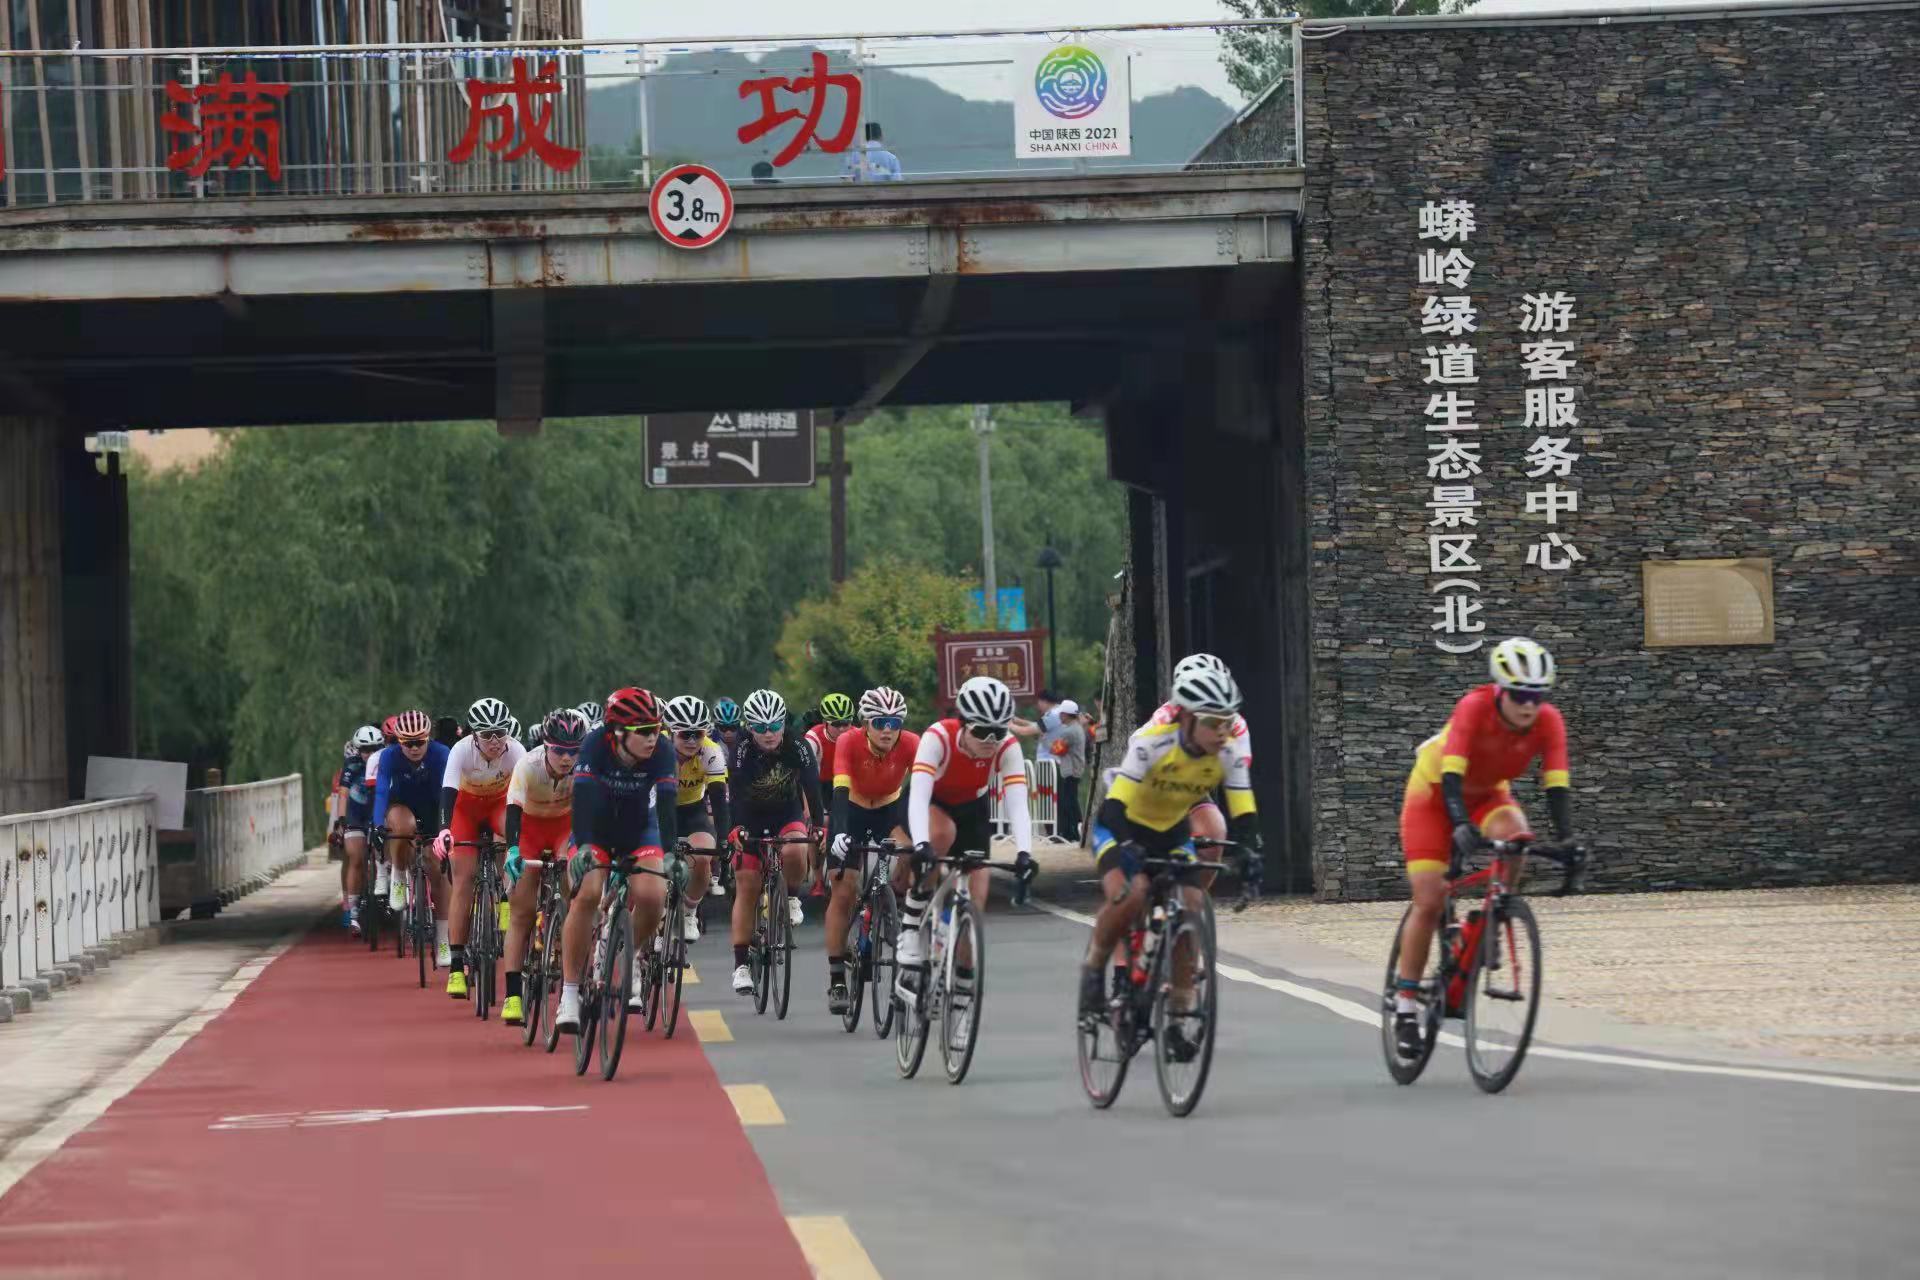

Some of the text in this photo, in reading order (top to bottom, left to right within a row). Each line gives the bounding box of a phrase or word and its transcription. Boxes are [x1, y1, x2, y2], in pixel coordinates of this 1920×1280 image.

[1085, 127, 1118, 139] 2021
[1030, 141, 1118, 152] SHAANXI CHINA
[666, 189, 720, 223] 3.8m
[1519, 291, 1585, 570] 游客服务中心
